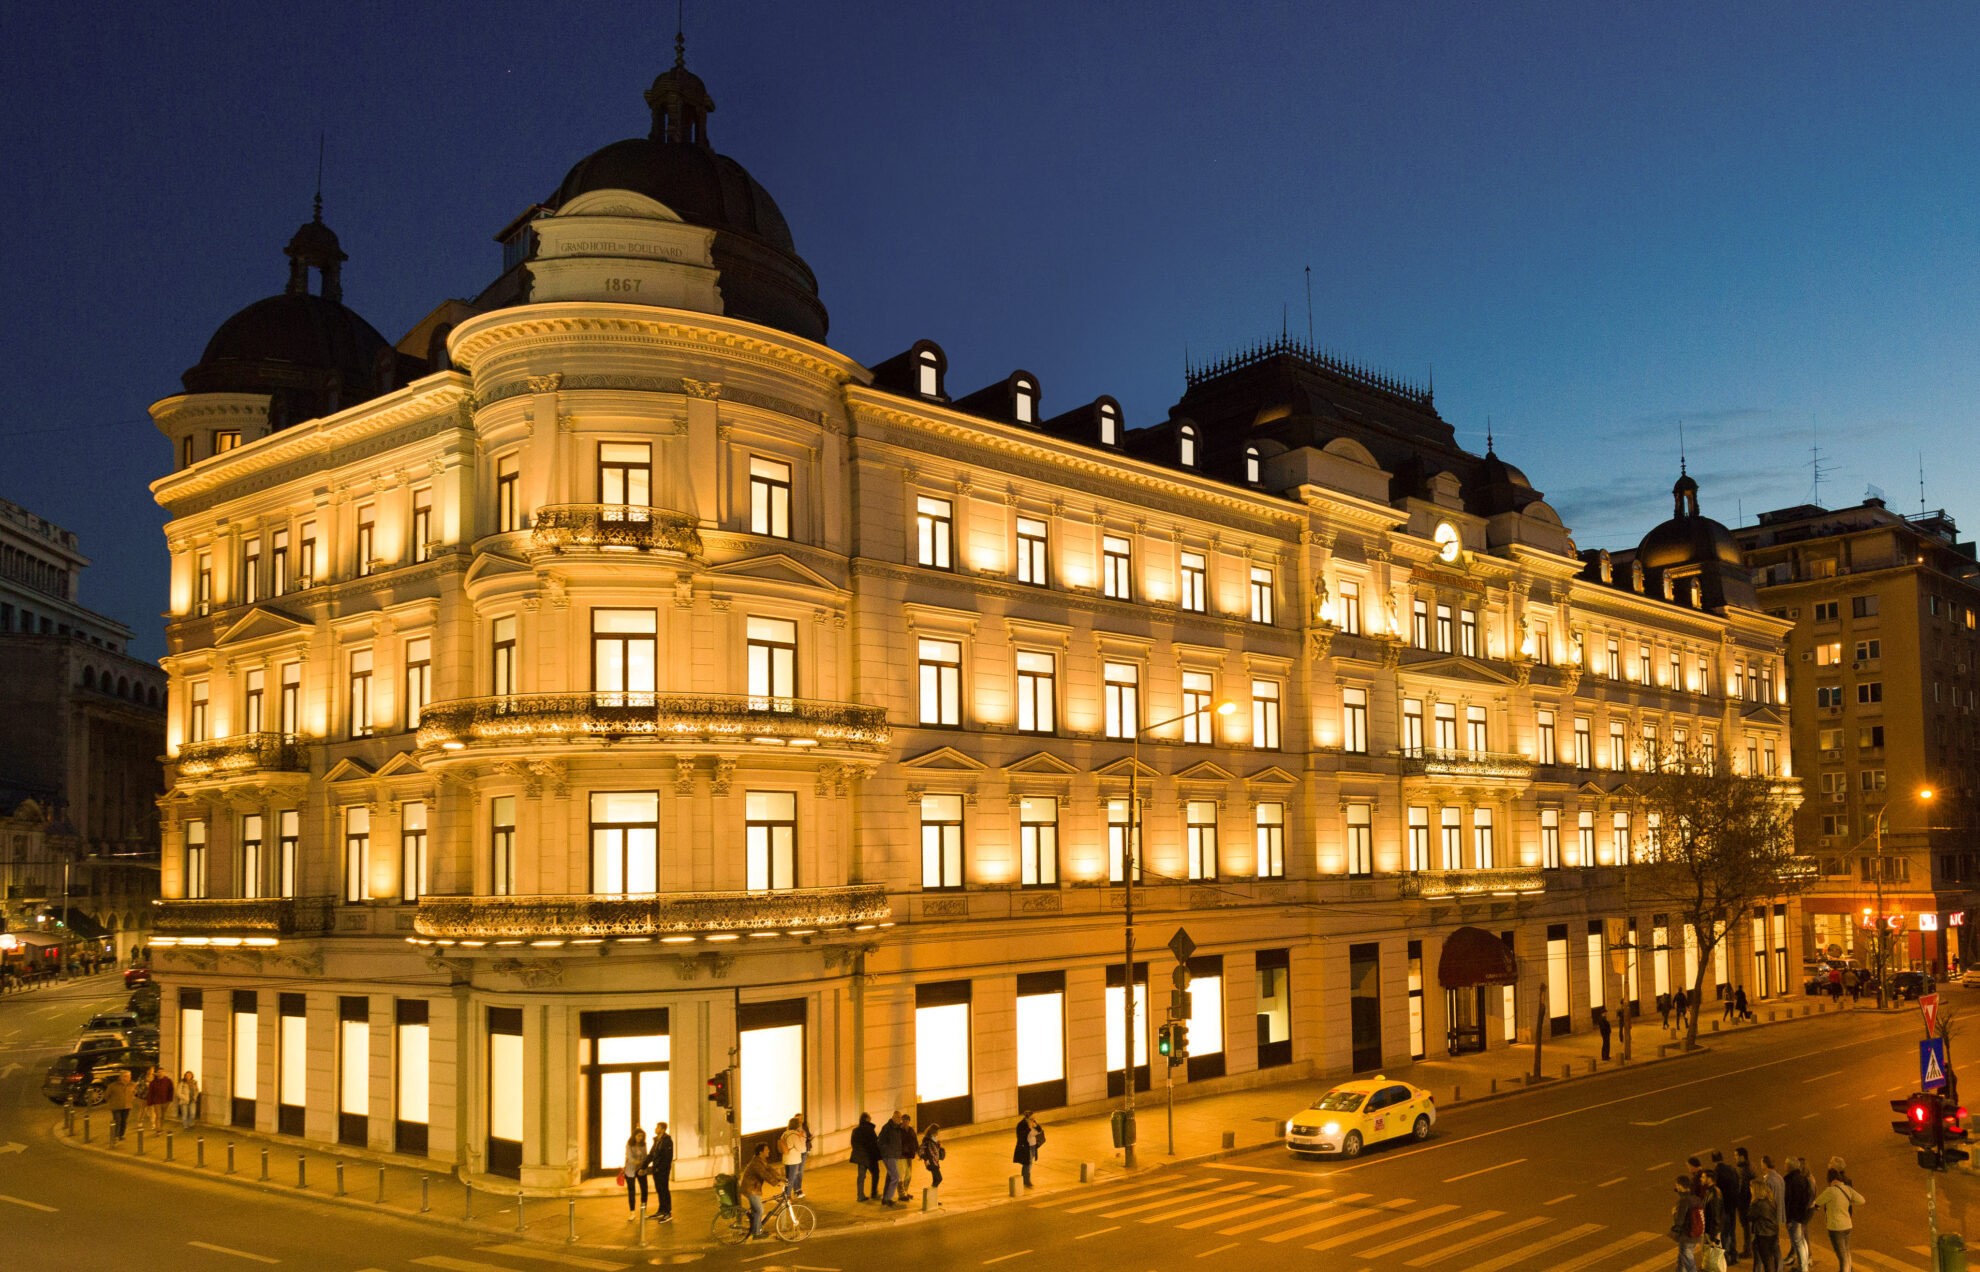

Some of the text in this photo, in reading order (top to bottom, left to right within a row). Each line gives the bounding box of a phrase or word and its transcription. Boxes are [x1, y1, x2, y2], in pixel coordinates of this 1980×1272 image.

[561, 241, 589, 252] GRAND
[590, 241, 617, 251] HOTEL
[628, 243, 683, 257] BOULEVARD
[605, 278, 642, 292] 1867
